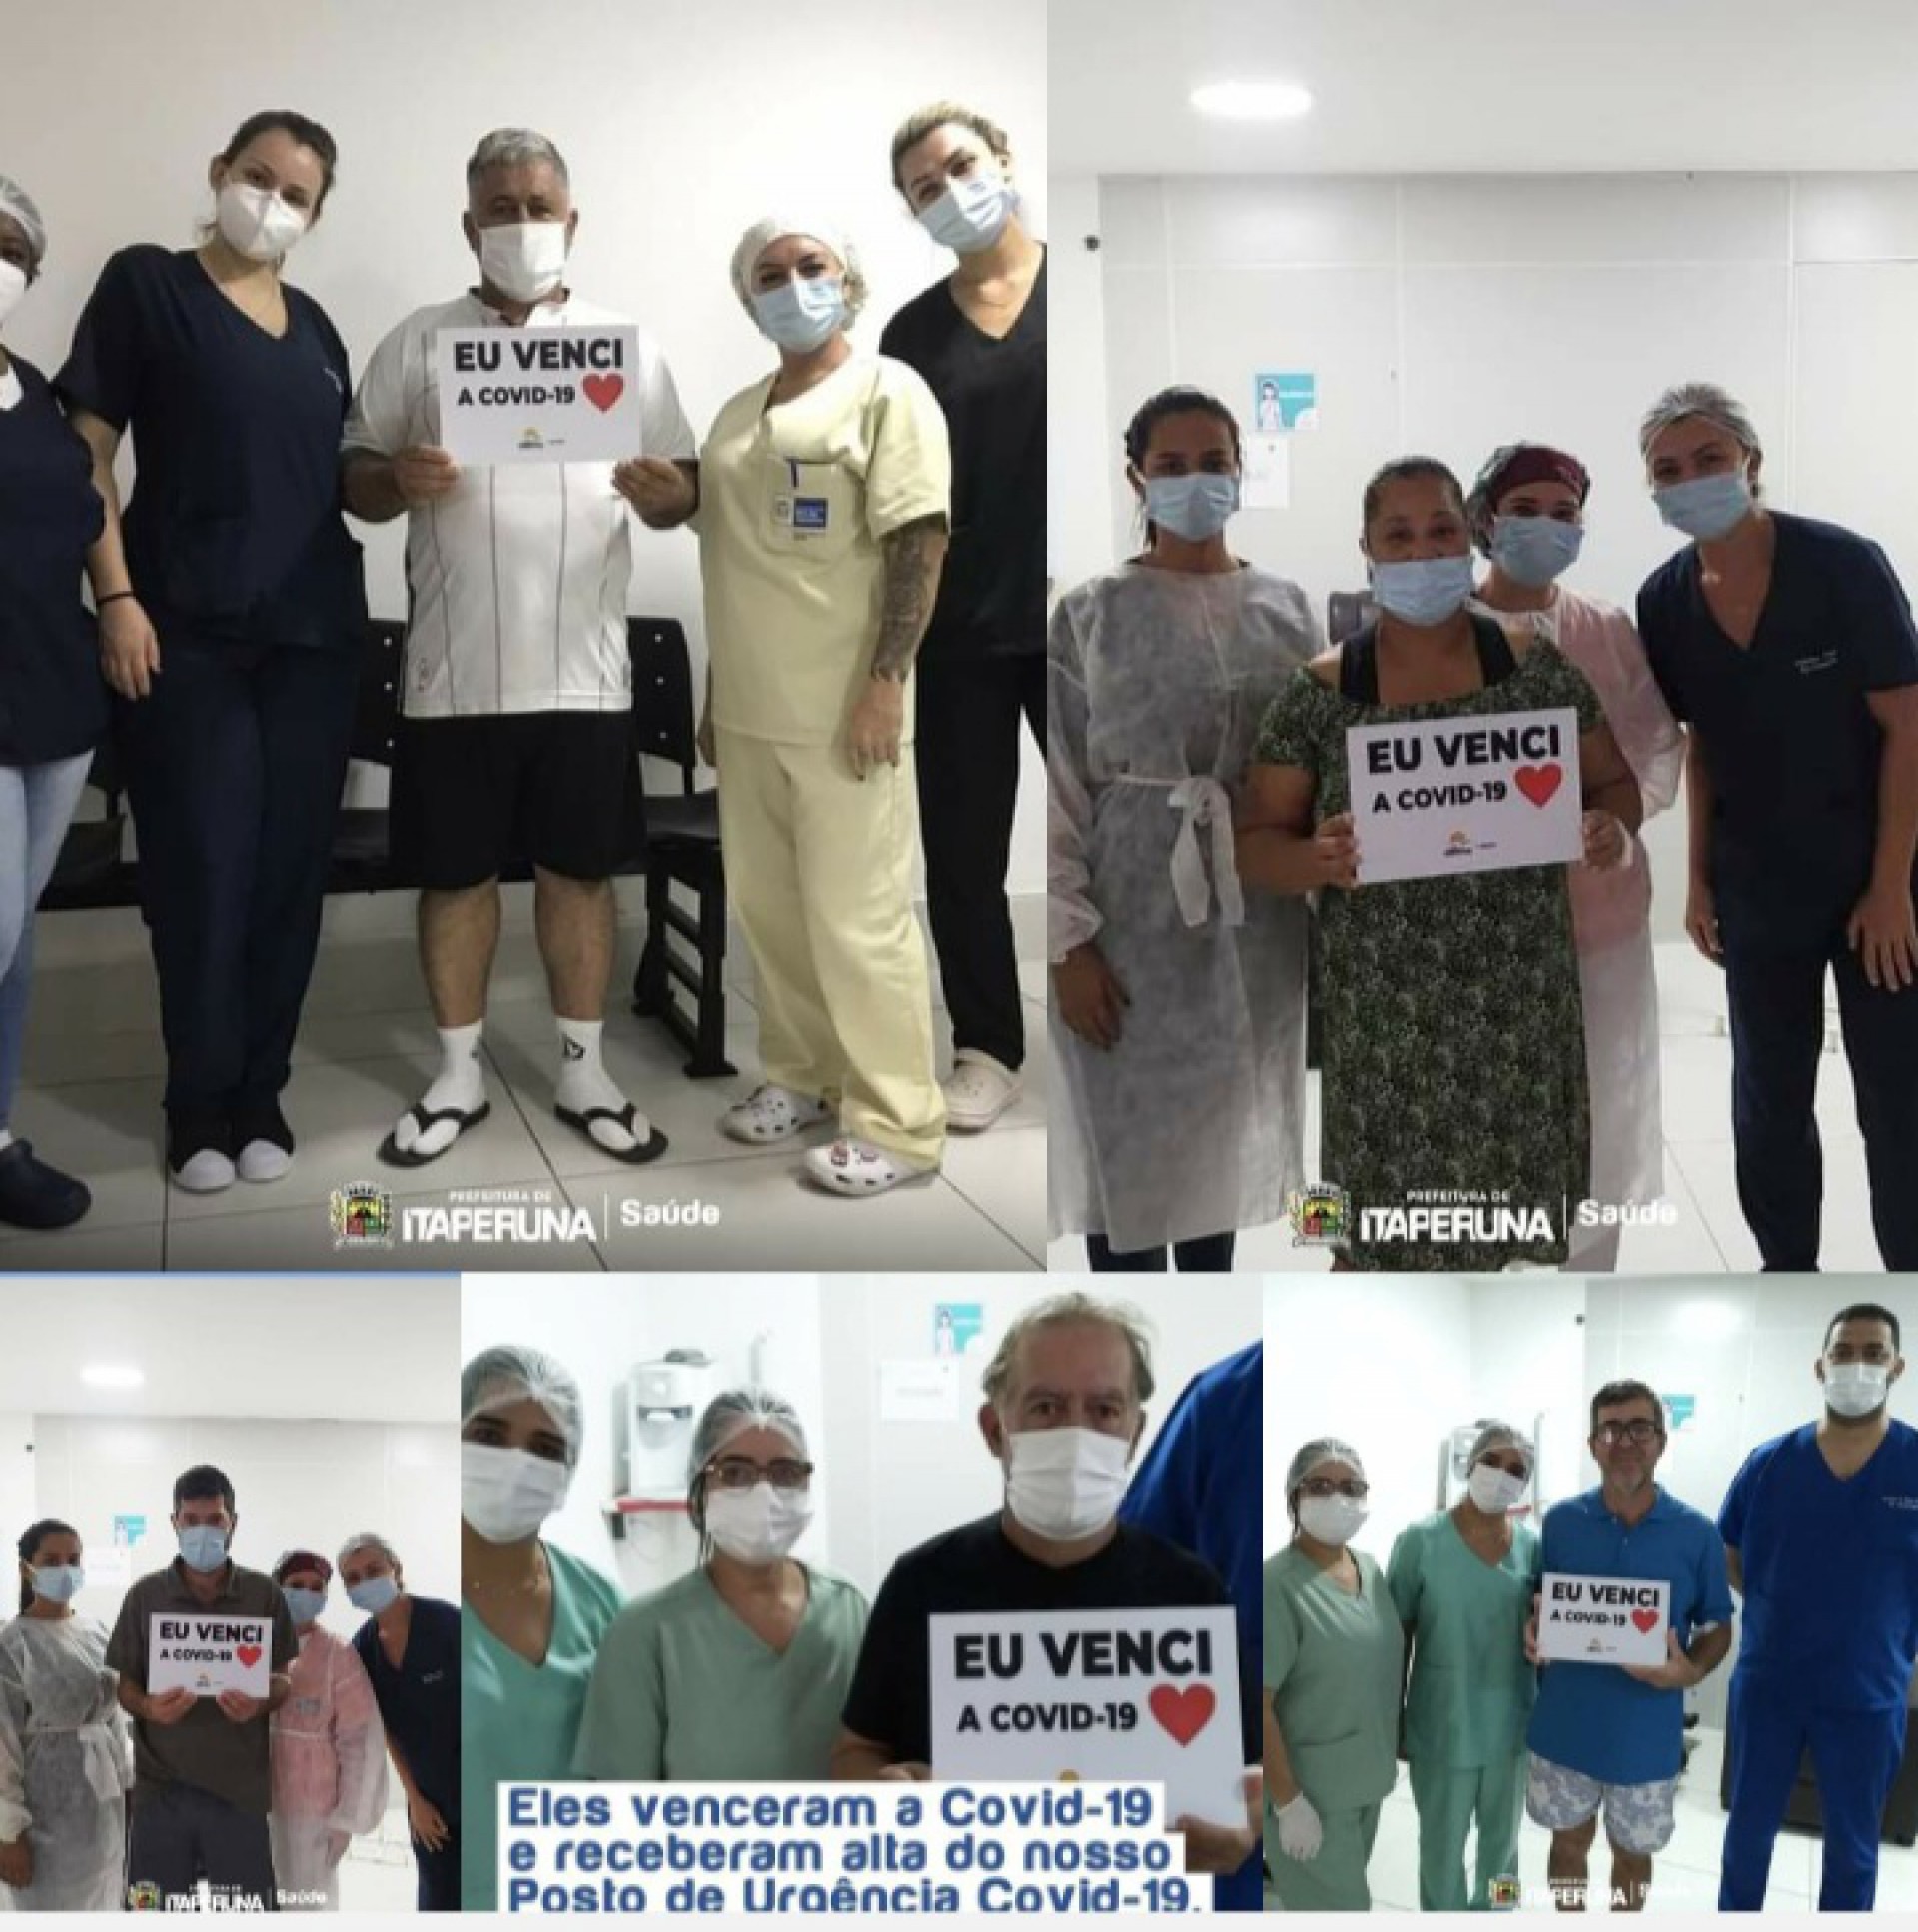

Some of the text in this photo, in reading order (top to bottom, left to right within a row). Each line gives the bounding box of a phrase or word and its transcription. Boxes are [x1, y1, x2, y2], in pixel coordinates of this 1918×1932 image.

[454, 338, 624, 371] EU VENCI
[457, 385, 576, 406] A COVID-19
[1367, 724, 1560, 775] EU VENCI
[1372, 779, 1508, 813] A COVID-19
[1552, 1581, 1660, 1608] EU VENCI
[160, 1619, 263, 1643] EU VENCI
[160, 1649, 170, 1661] A
[953, 1627, 1213, 1679] EU VENCI
[956, 1702, 1138, 1734] A COVID-19
